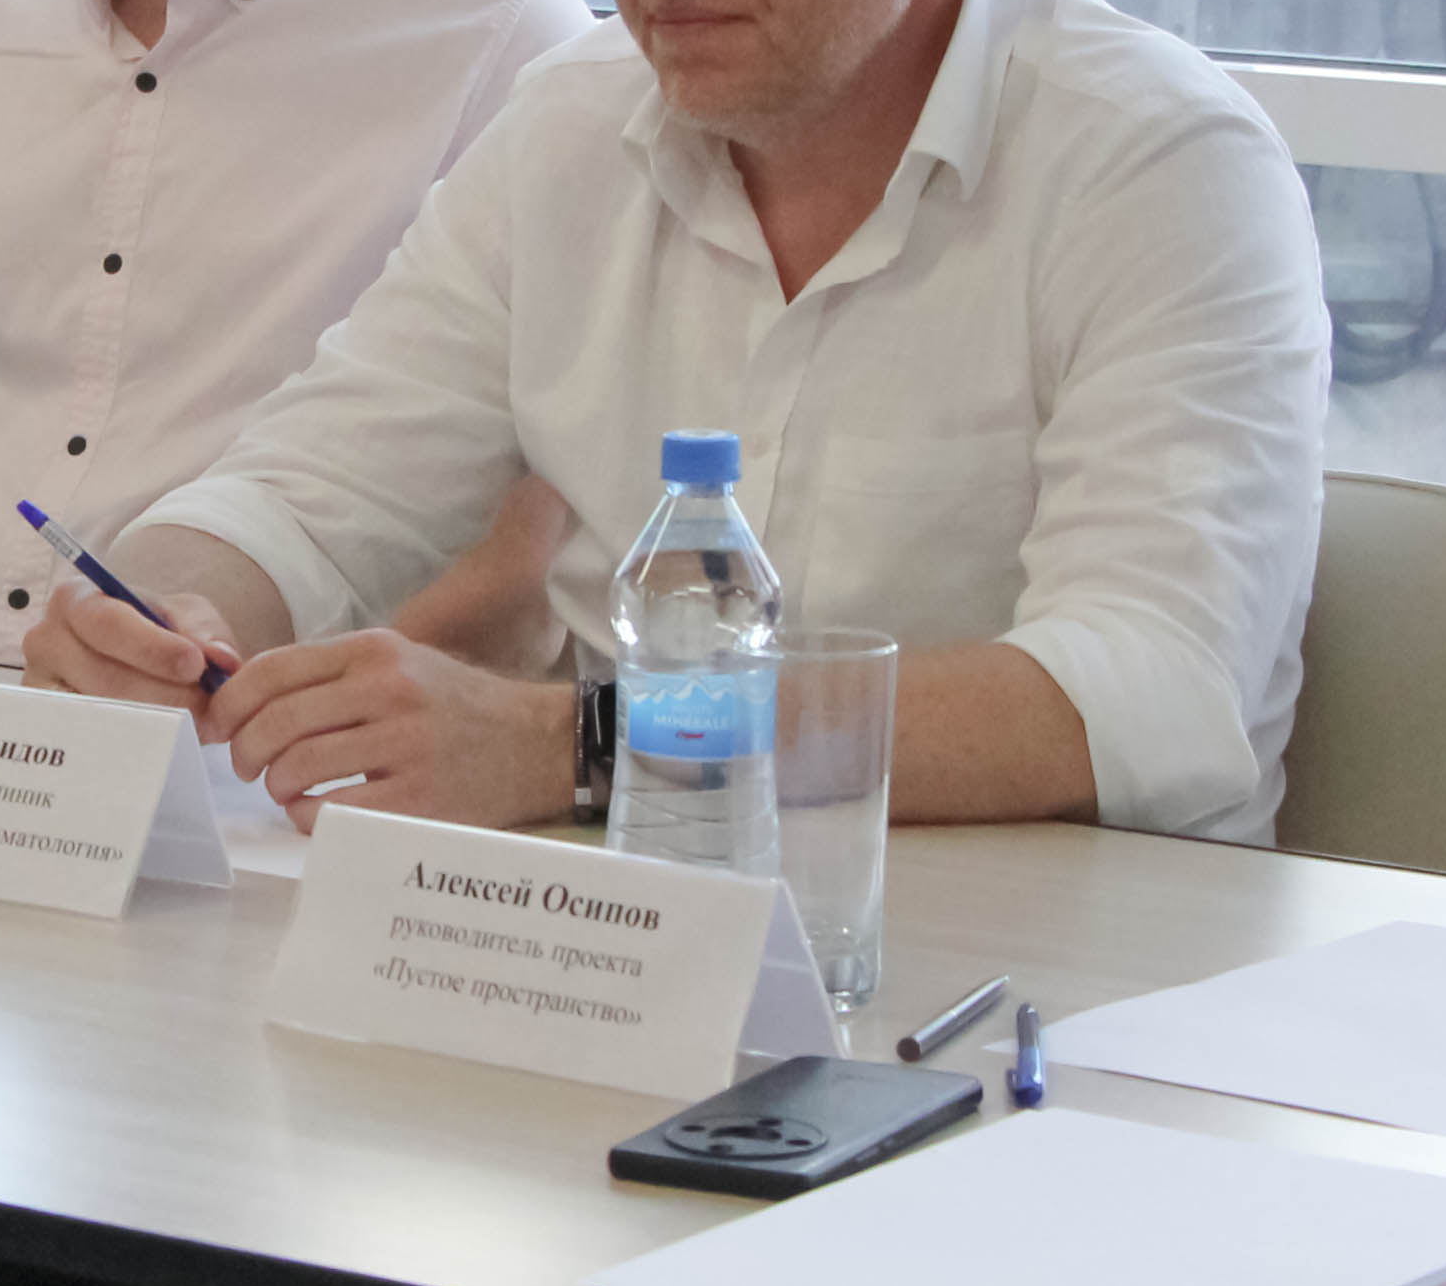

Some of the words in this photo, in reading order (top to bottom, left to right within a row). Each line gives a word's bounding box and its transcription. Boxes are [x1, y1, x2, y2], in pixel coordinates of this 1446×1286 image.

[404, 861, 533, 908] Алексей
[542, 883, 660, 931] Осипов
[390, 915, 544, 960] руководитель
[551, 944, 643, 978] проекта
[373, 957, 465, 994] «Пустое
[471, 978, 642, 1026] пространство»
